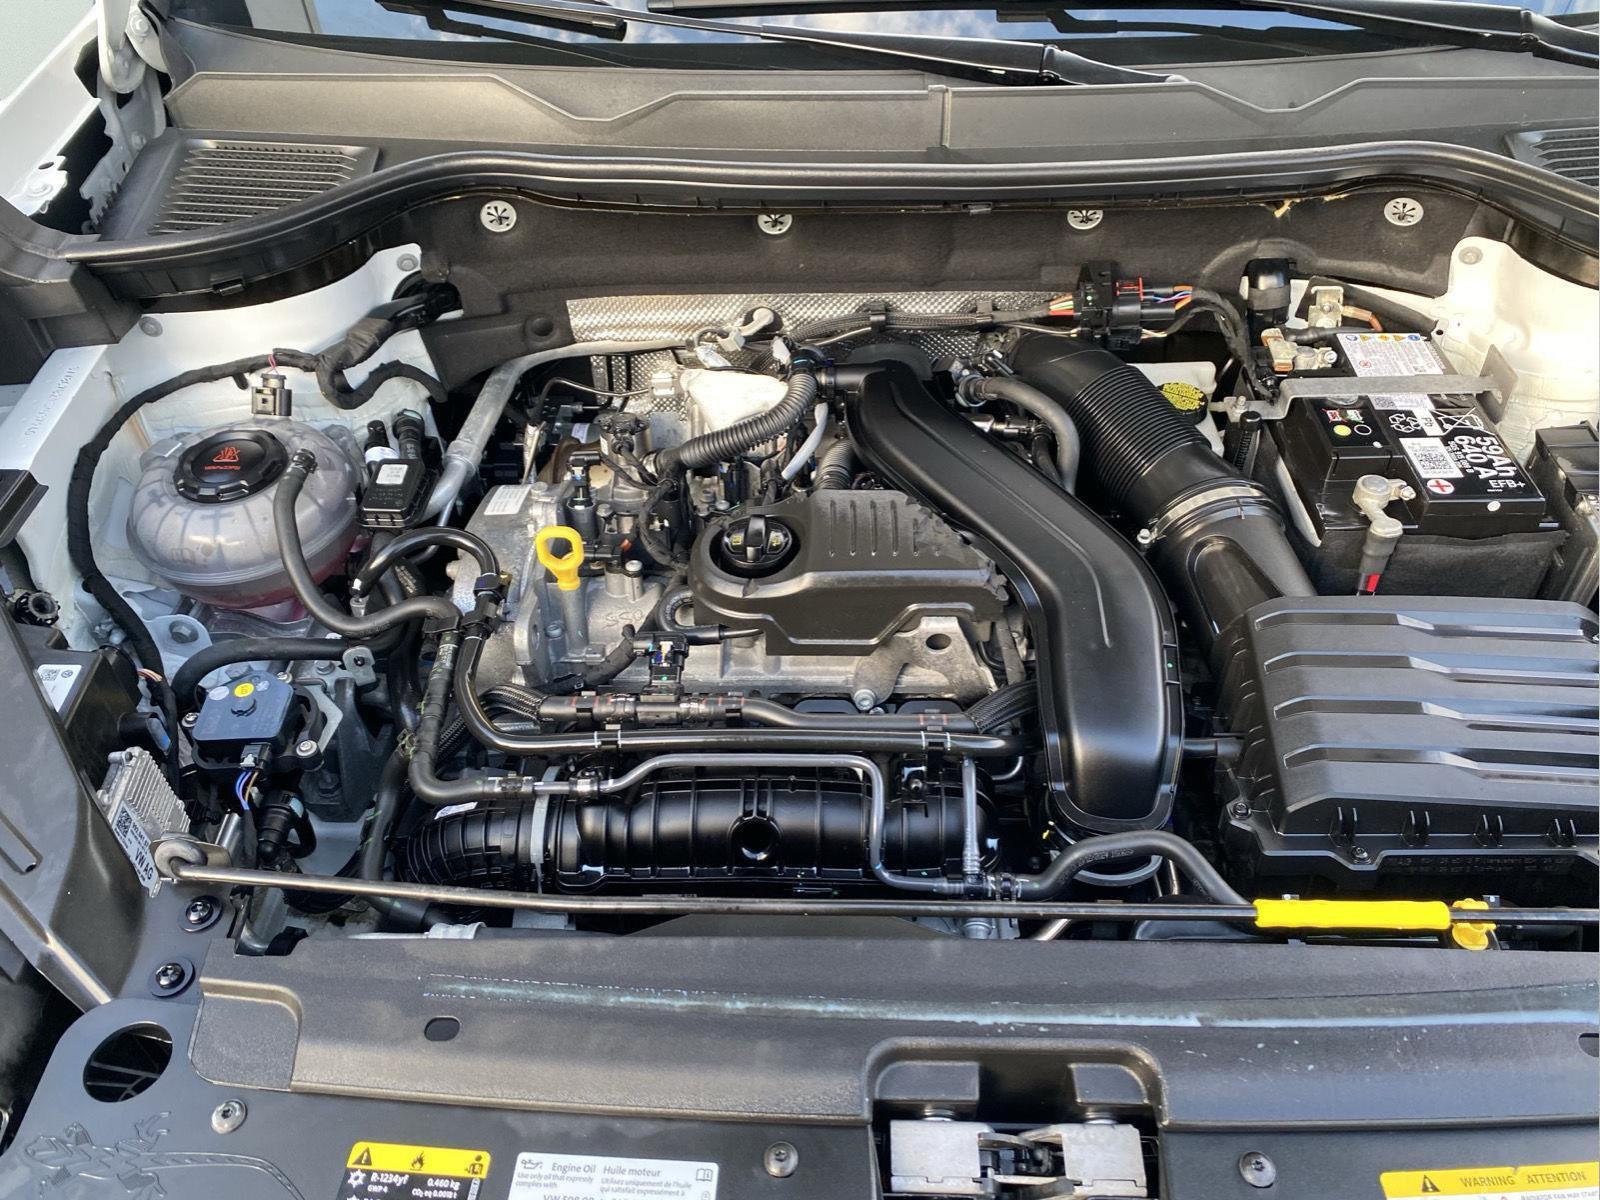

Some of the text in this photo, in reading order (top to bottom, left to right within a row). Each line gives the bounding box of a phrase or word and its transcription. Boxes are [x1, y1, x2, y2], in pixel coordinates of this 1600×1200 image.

[1453, 435, 1488, 463] 640
[1474, 466, 1498, 479] A
[1476, 436, 1517, 477] 59Ah
[1488, 479, 1526, 489] EFB+
[135, 848, 146, 868] VW
[143, 862, 154, 880] AG
[551, 1162, 596, 1174] Engine Oil
[603, 1165, 661, 1177] Huile moteur
[370, 1172, 410, 1187] R-1234yf
[427, 1178, 450, 1188] 0.460
[450, 1180, 461, 1191] kg
[565, 1175, 594, 1183] expressly
[1460, 1171, 1587, 1188] WARNING ATTENTION
[600, 1186, 610, 1194] qui
